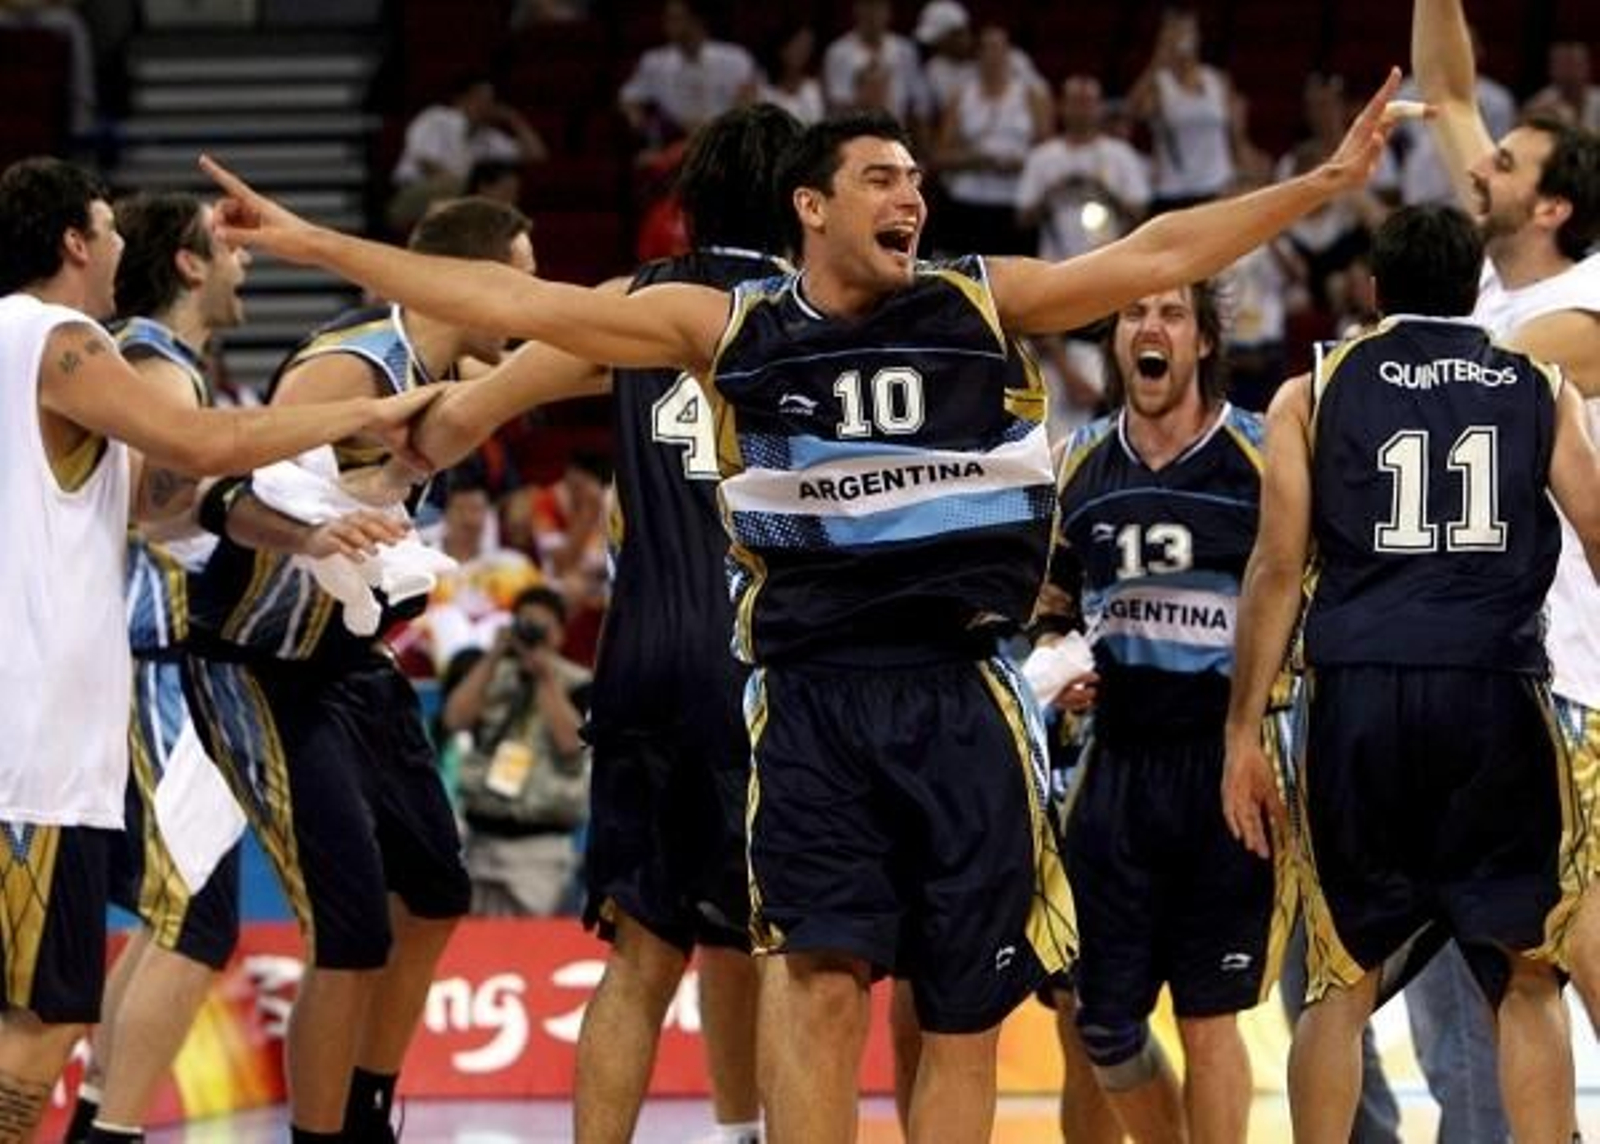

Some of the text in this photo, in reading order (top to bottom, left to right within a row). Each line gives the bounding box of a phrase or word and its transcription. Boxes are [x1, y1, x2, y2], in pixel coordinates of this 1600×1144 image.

[1379, 358, 1518, 390] QUINTEROS
[652, 371, 721, 480] 4
[832, 366, 925, 440] 10
[799, 460, 985, 502] ARGENTINA
[1374, 425, 1508, 553] 11
[1115, 523, 1194, 579] 13
[1101, 598, 1228, 630] GENTINA
